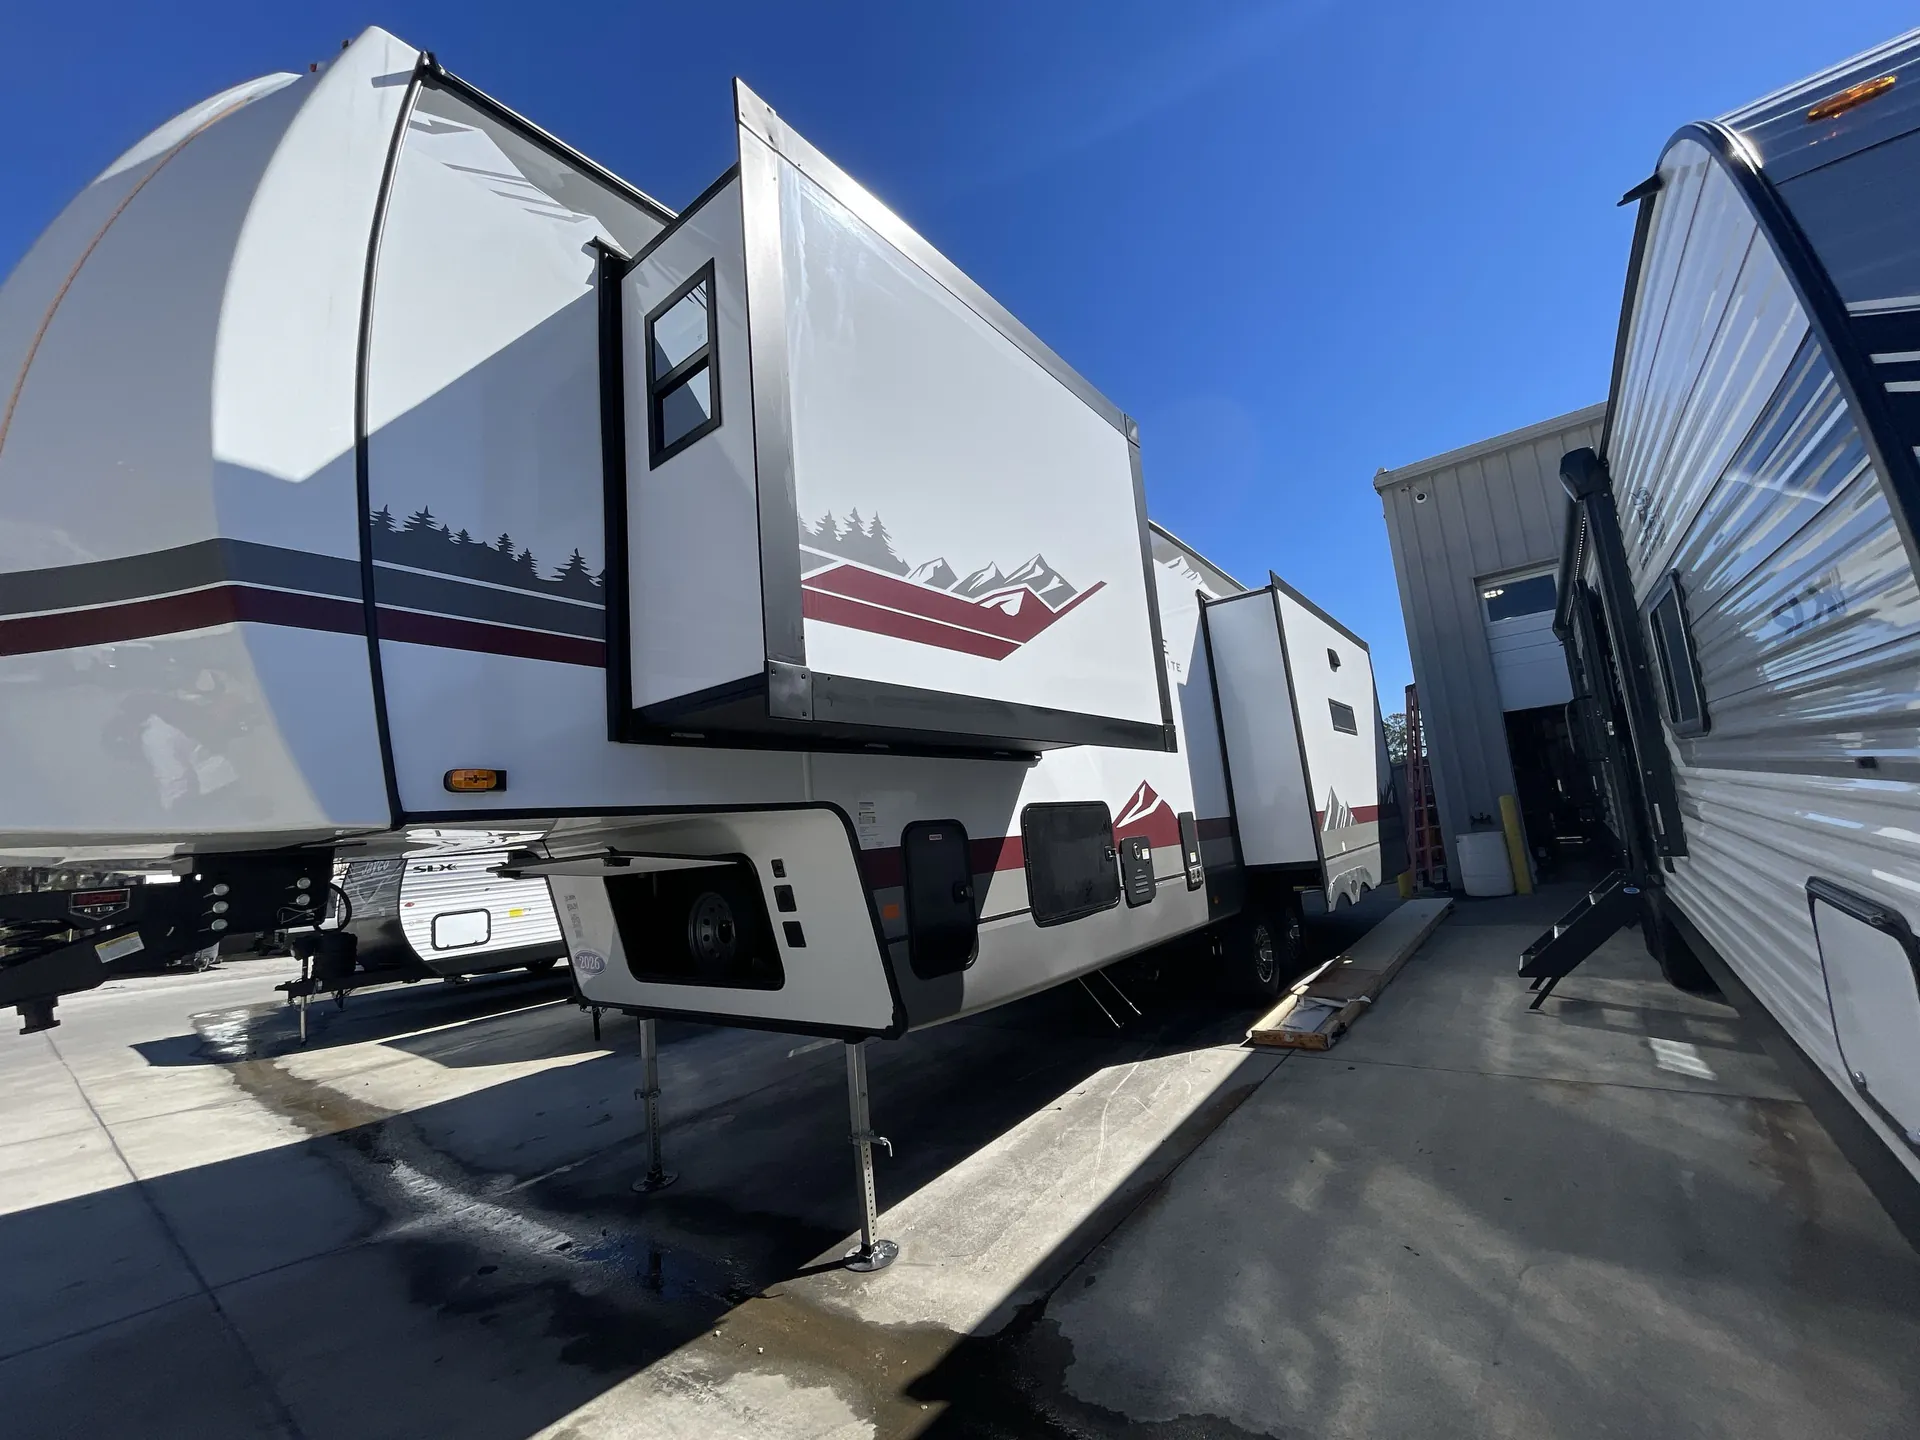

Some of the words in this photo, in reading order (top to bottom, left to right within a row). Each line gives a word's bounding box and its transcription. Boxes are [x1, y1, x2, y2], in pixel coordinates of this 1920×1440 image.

[1167, 659, 1181, 673] ITE
[413, 863, 457, 874] SLX
[579, 955, 601, 969] 2026
